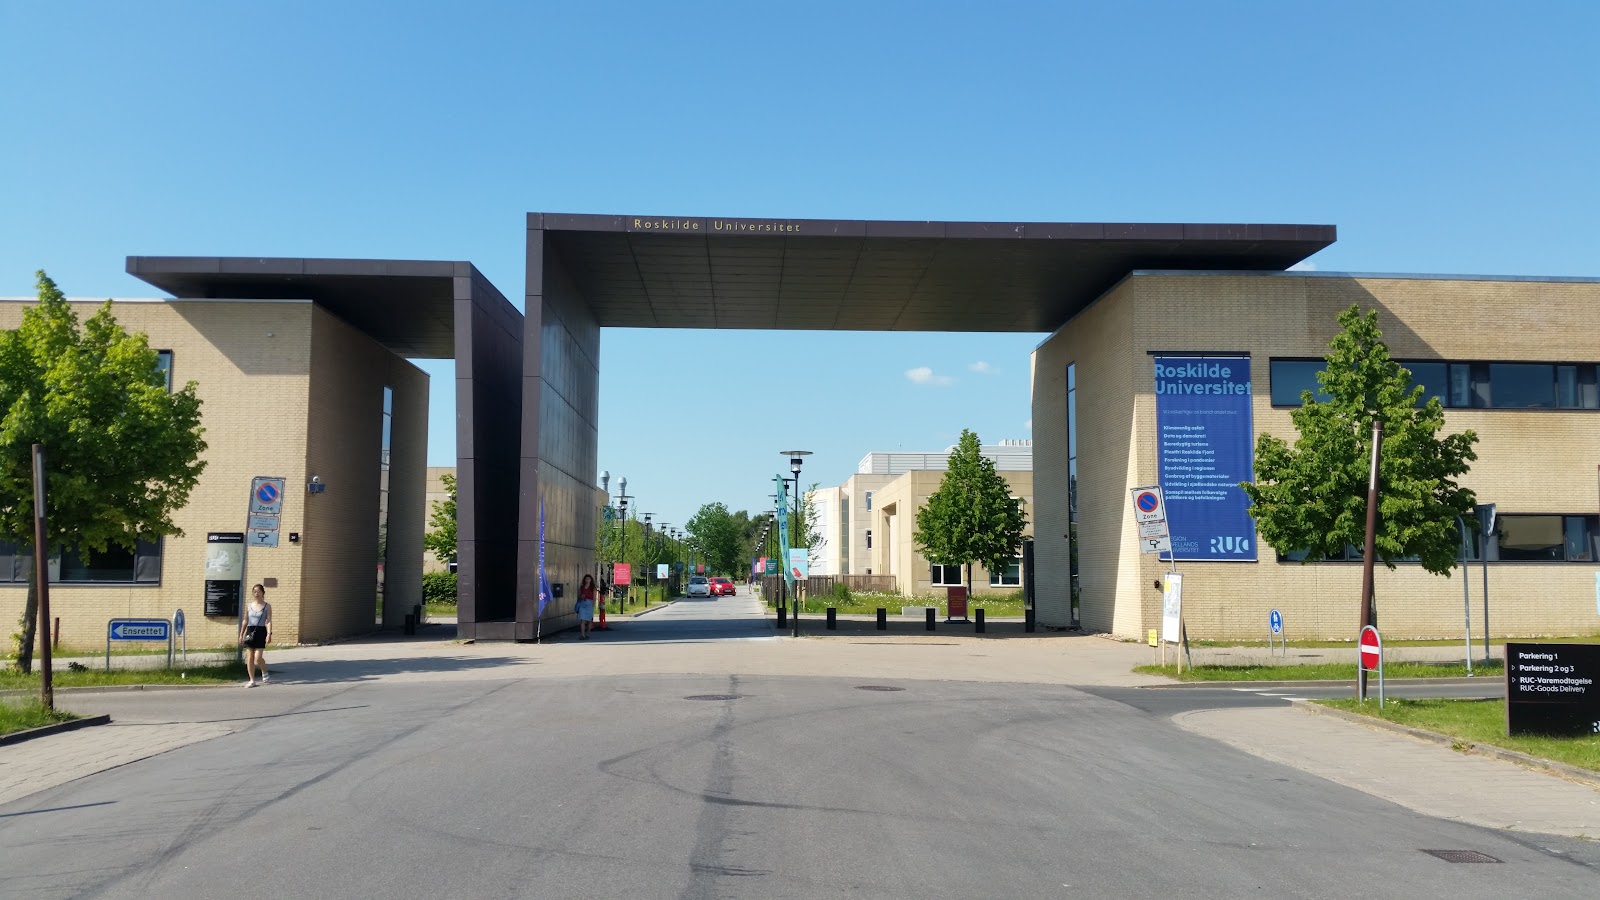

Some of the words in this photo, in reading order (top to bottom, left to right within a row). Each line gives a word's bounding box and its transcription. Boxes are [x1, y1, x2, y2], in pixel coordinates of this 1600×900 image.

[634, 218, 699, 230] Roskilde
[714, 220, 801, 232] Universitet
[1154, 363, 1232, 378] Roskilde
[1155, 380, 1252, 395] Universitet
[1210, 536, 1249, 553] RUC
[122, 627, 162, 635] Ensrettet
[1519, 653, 1553, 661] Parkering
[1519, 665, 1553, 673] Parkering
[1520, 677, 1592, 685] RUC-Varemodtagelse
[1560, 685, 1586, 693] Delivery
